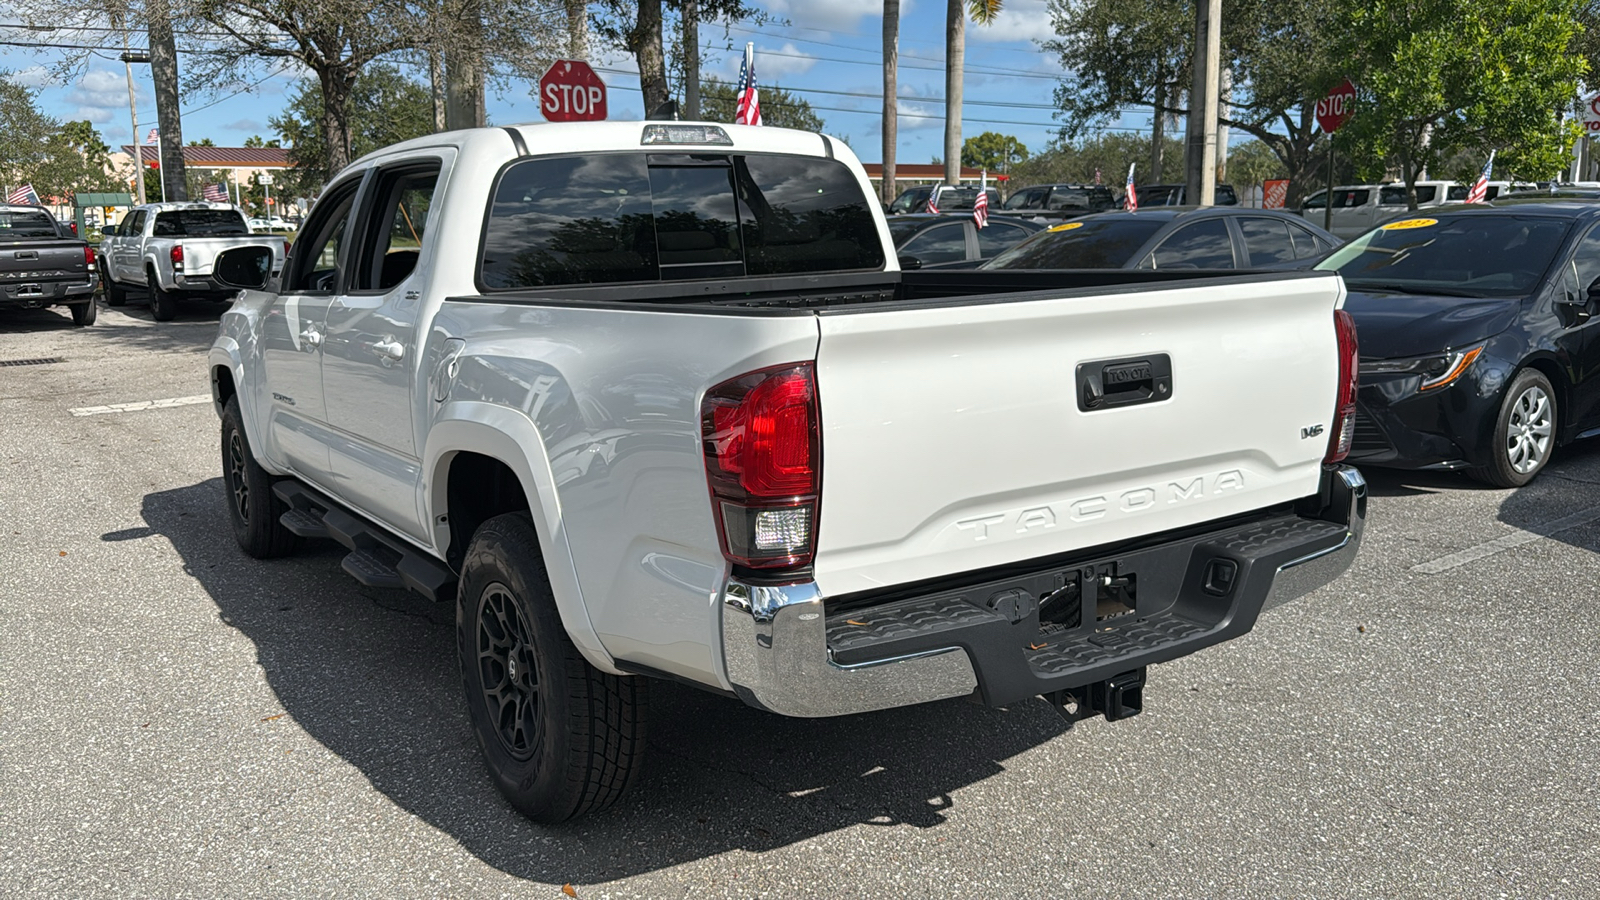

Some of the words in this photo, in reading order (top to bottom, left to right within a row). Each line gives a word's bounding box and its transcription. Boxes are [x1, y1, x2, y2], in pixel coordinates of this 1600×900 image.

[546, 83, 602, 115] STOP
[1110, 367, 1152, 383] TOYOTA
[1301, 424, 1323, 440] V6
[956, 469, 1245, 542] TACOMA
